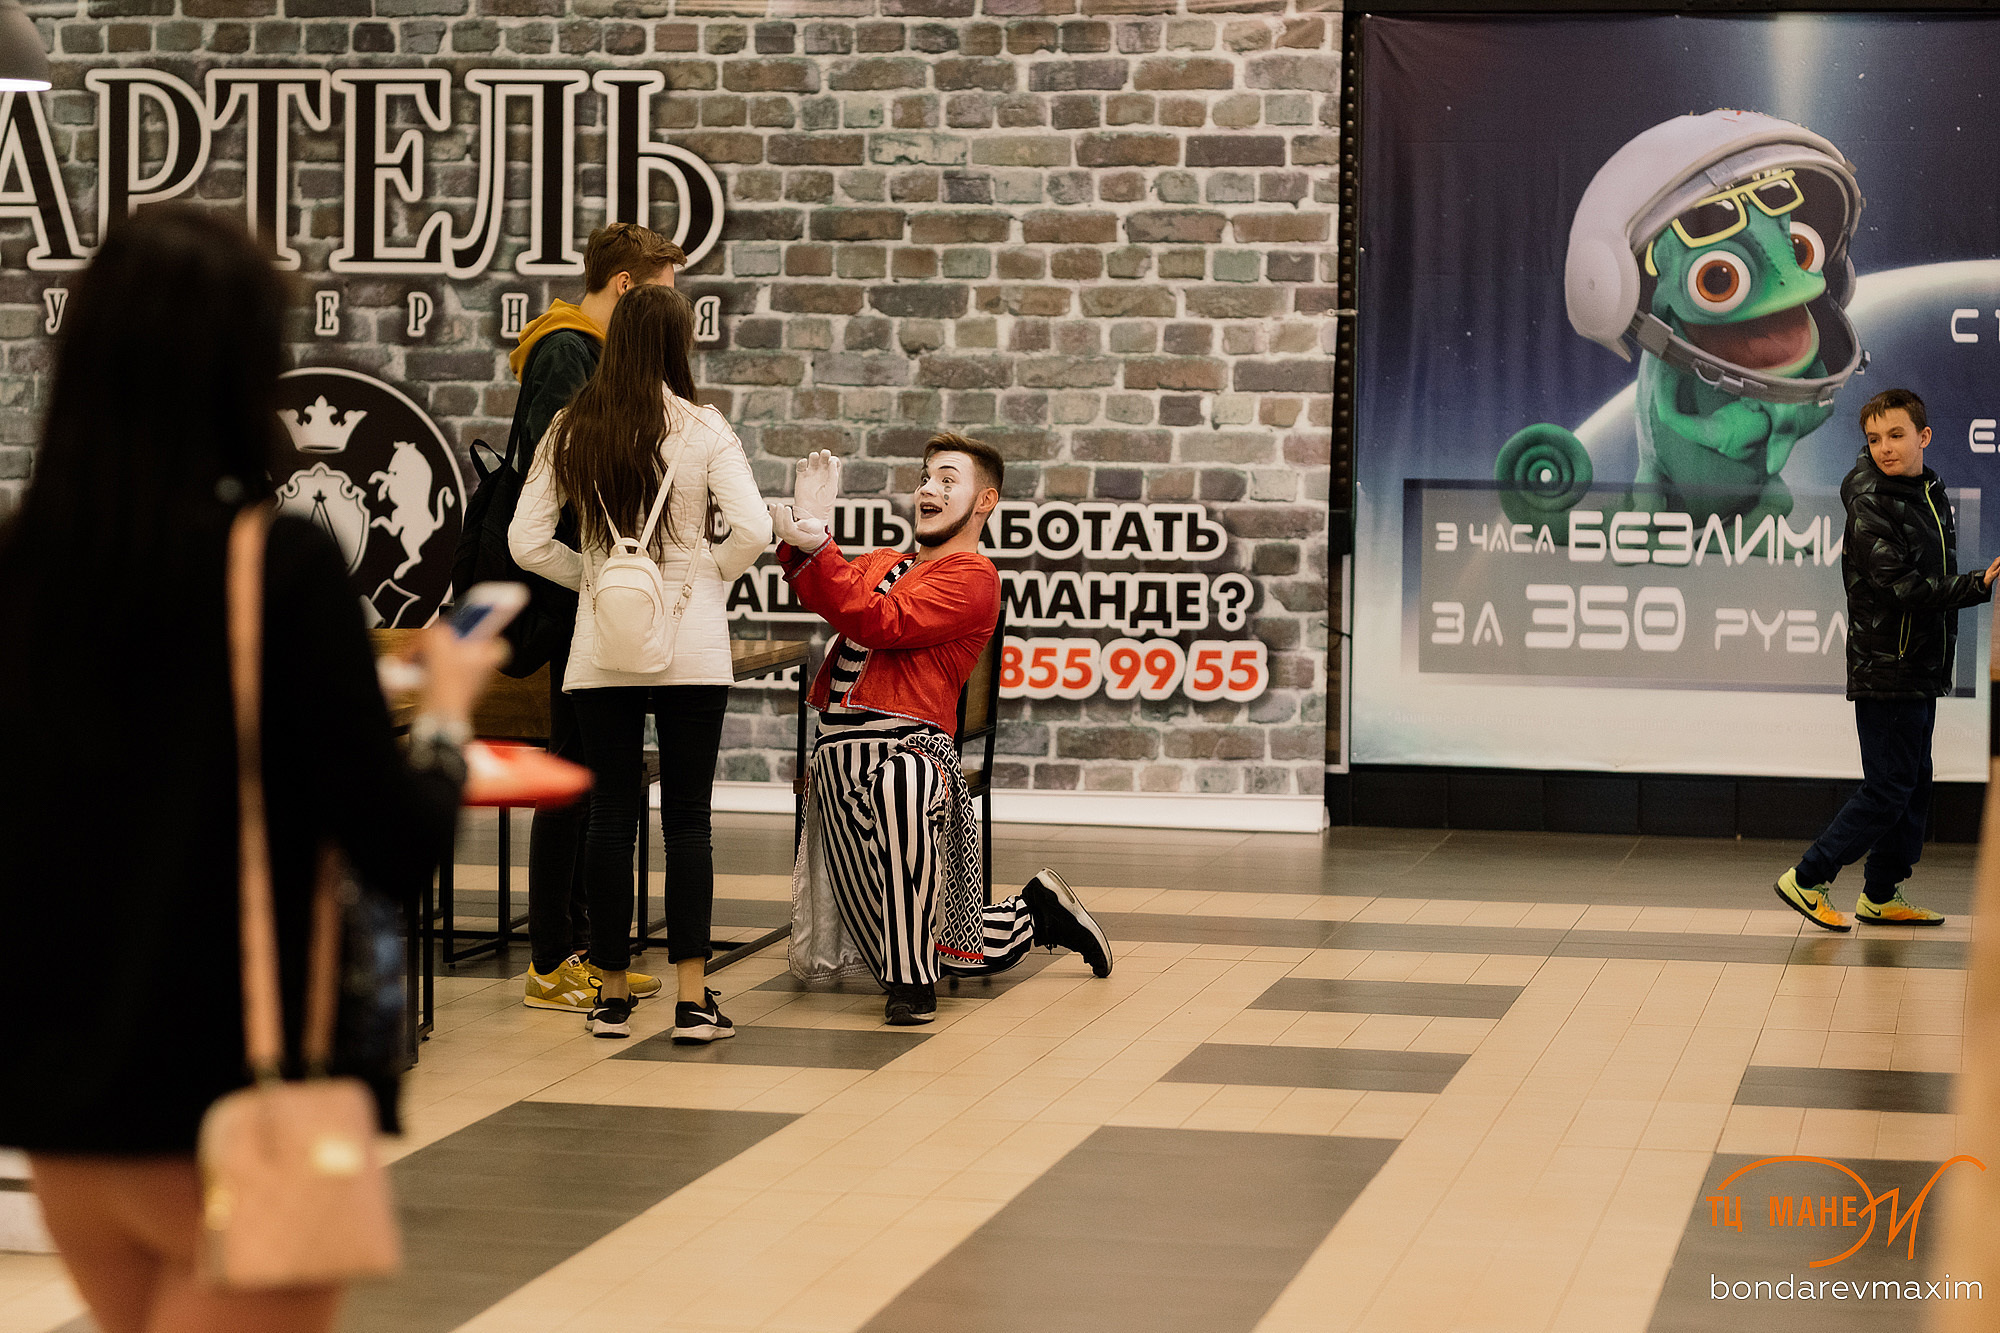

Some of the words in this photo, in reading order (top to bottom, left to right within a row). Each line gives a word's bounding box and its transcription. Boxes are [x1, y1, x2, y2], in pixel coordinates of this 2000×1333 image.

[1469, 523, 1555, 554] ЧАСА
[1525, 584, 1686, 651] 350
[1109, 648, 1176, 691] 99
[1193, 650, 1259, 692] 55
